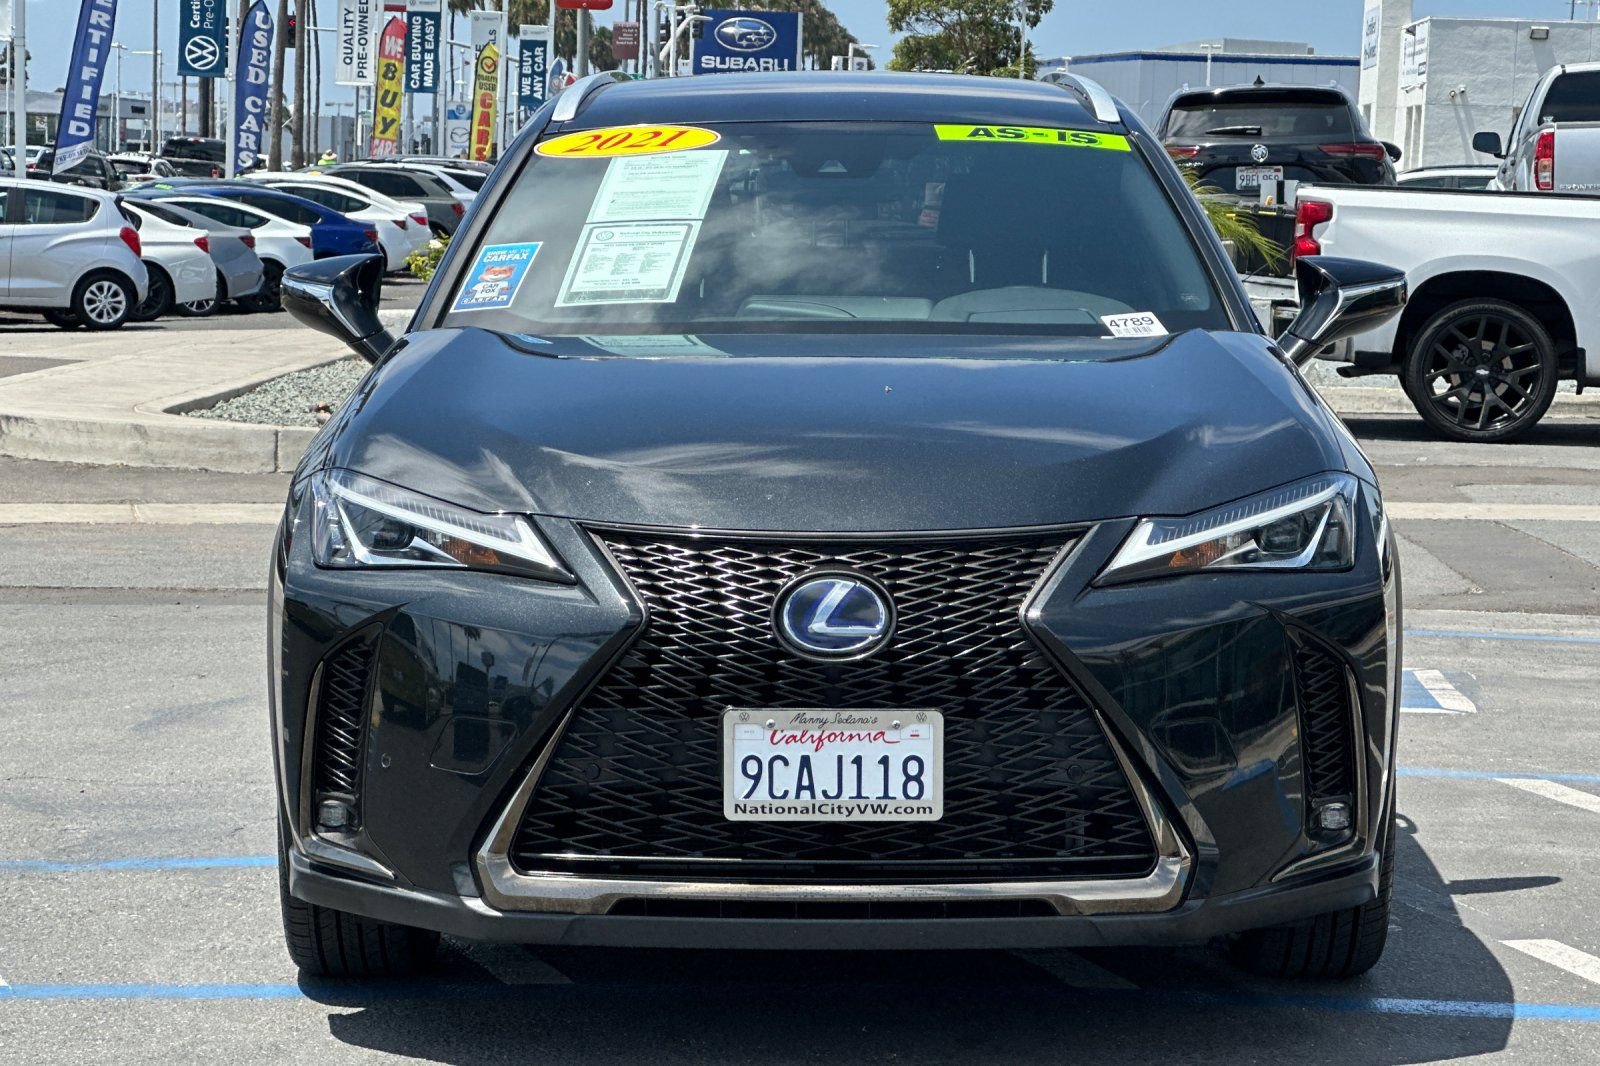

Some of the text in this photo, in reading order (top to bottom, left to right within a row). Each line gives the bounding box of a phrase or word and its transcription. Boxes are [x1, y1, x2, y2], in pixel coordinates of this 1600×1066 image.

[343, 8, 354, 65] QUALITY
[411, 16, 421, 88] CAR BUYING
[423, 18, 435, 87] MADE EASY
[521, 50, 532, 96] WE BUY
[533, 47, 544, 100] ANY CAR
[700, 55, 789, 72] SUBARU
[238, 10, 272, 167] USED CARS
[379, 62, 400, 134] BUY
[475, 92, 492, 161] CARS
[562, 130, 689, 153] 2021
[483, 252, 529, 262] CARFAX
[1109, 316, 1154, 328] 4789
[770, 729, 901, 753] California
[789, 712, 829, 729] Manny
[740, 754, 925, 801] 9CAJ118
[734, 803, 933, 817] NationalCityVW.com
